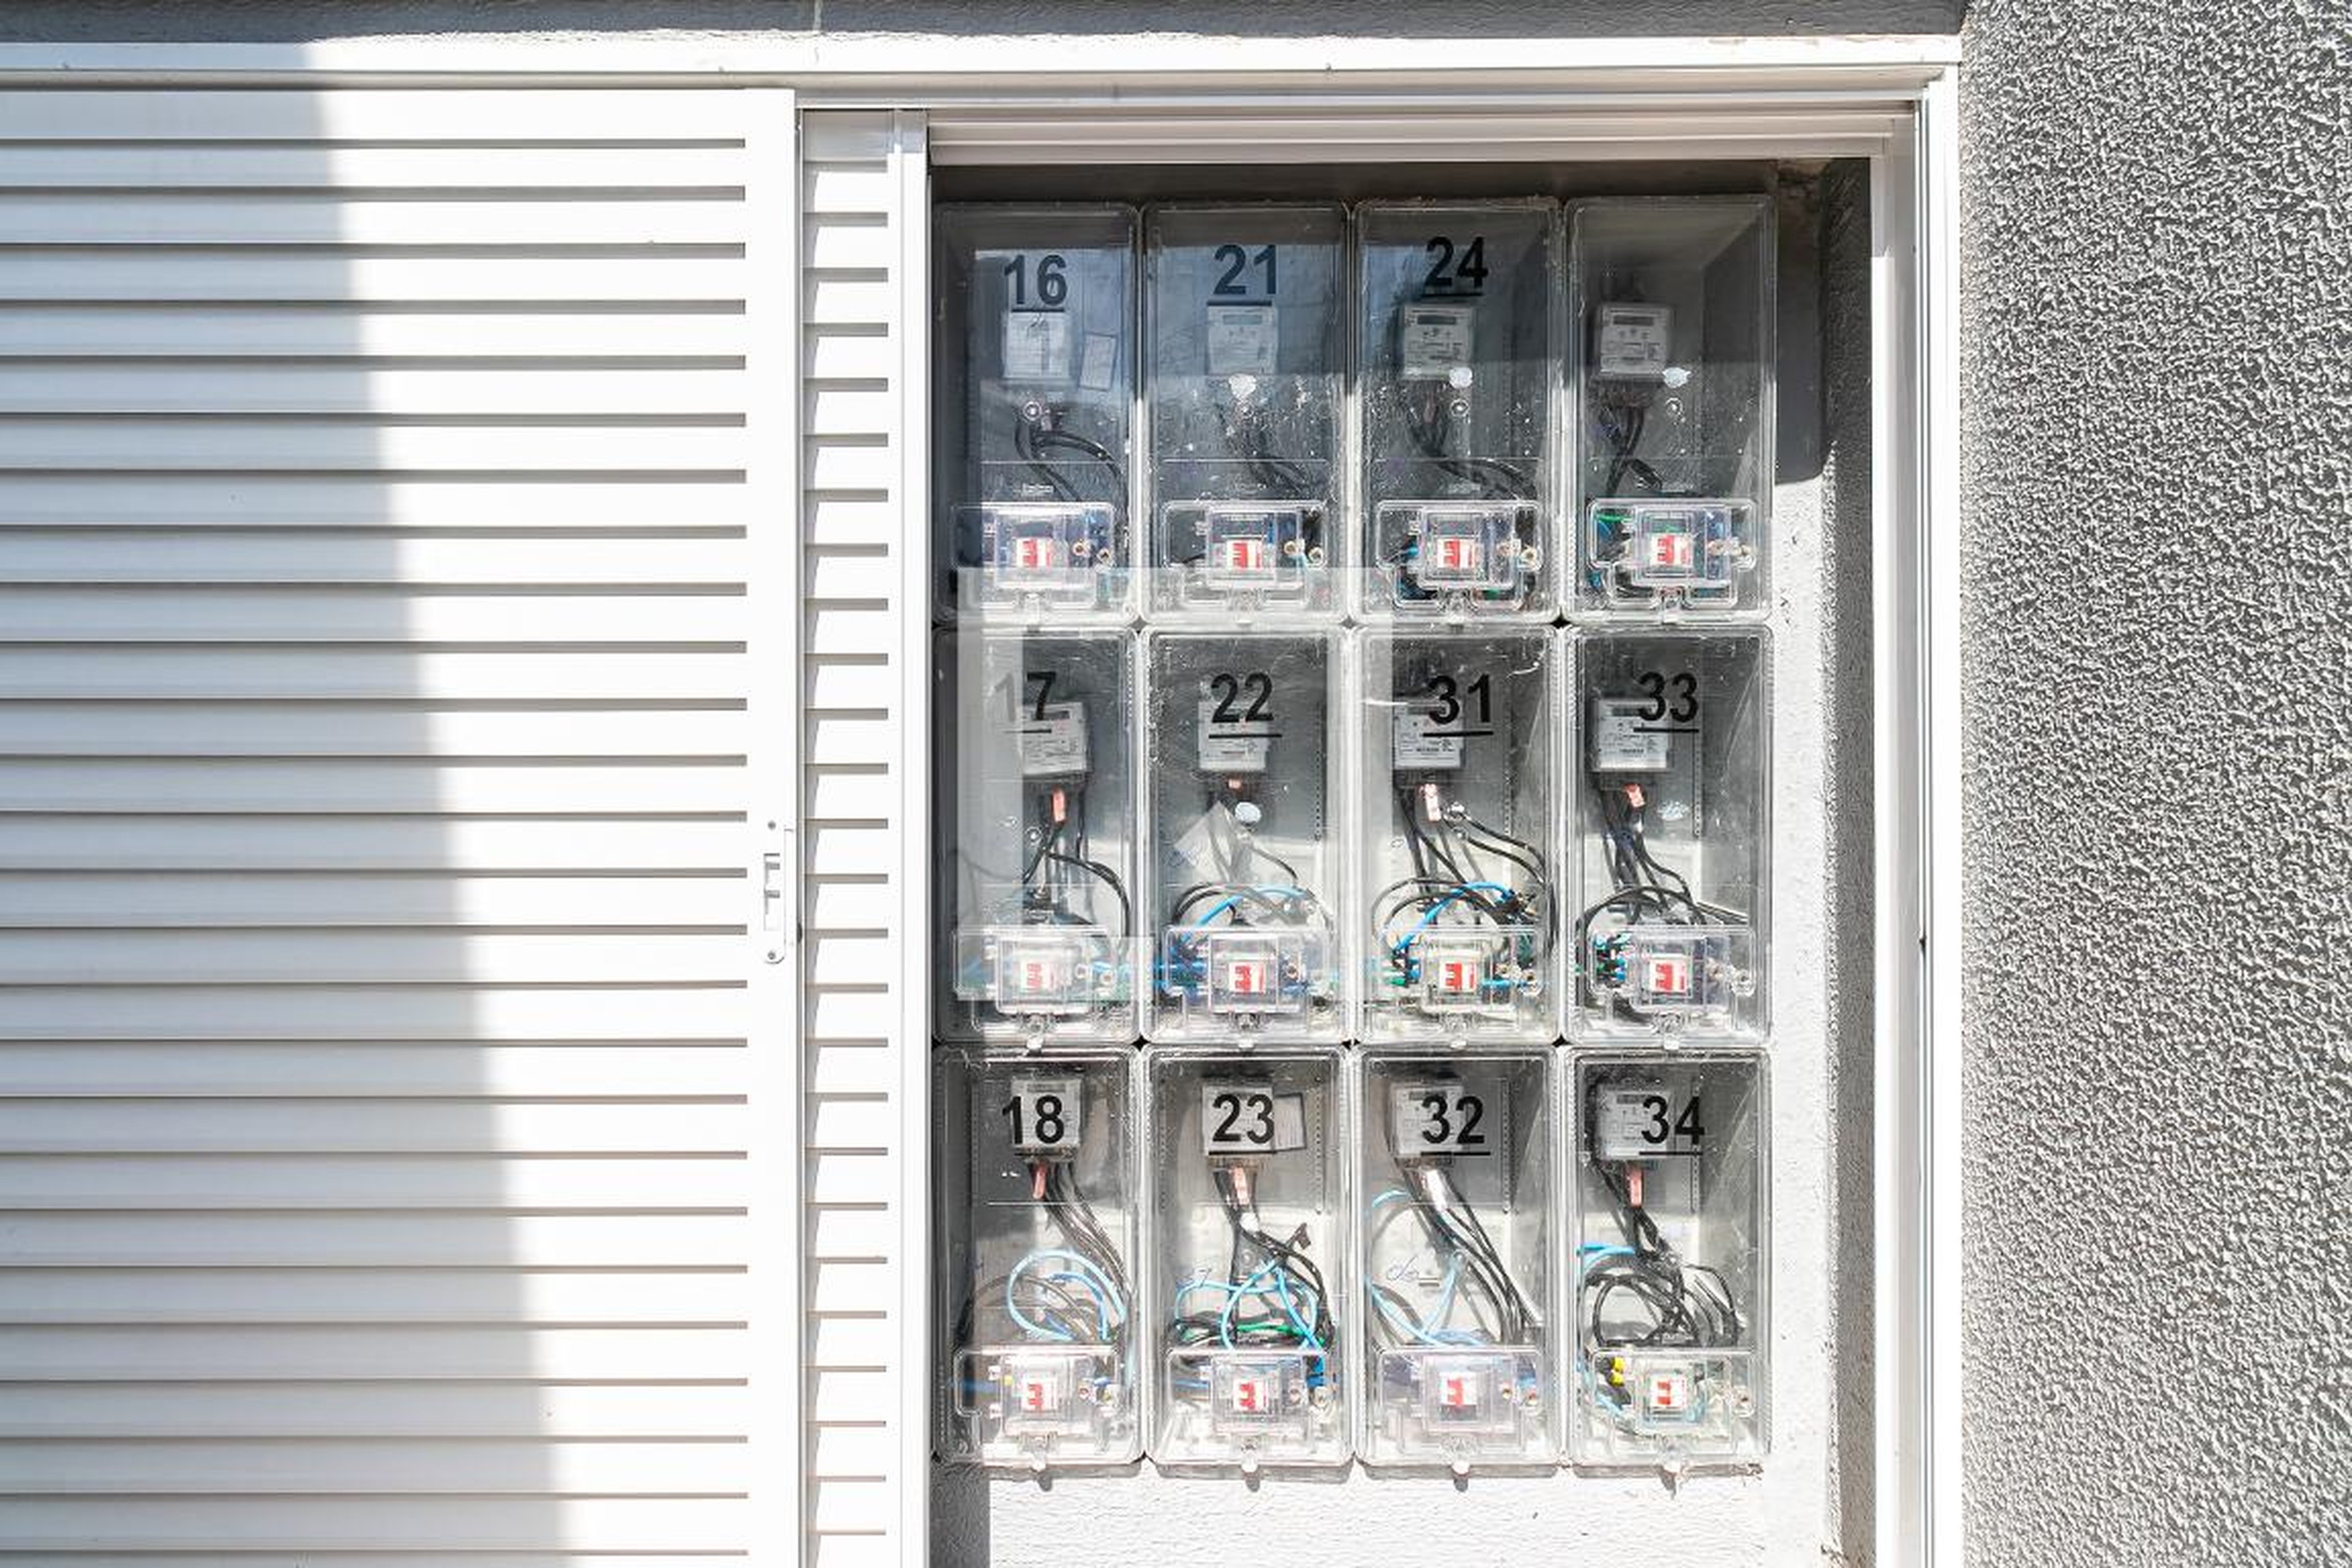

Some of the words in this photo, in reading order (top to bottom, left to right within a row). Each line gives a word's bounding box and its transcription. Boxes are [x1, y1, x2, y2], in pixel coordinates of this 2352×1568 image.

[1003, 254, 1068, 306] 16
[1213, 244, 1276, 295] 21
[1424, 236, 1488, 287] 24
[994, 671, 1057, 722] 17
[1211, 673, 1275, 723] 22
[1428, 674, 1491, 725] 31
[1637, 672, 1699, 722] 33
[1001, 1095, 1065, 1145] 18
[1212, 1094, 1275, 1144] 23
[1421, 1095, 1485, 1144] 32
[1641, 1095, 1706, 1145] 34
